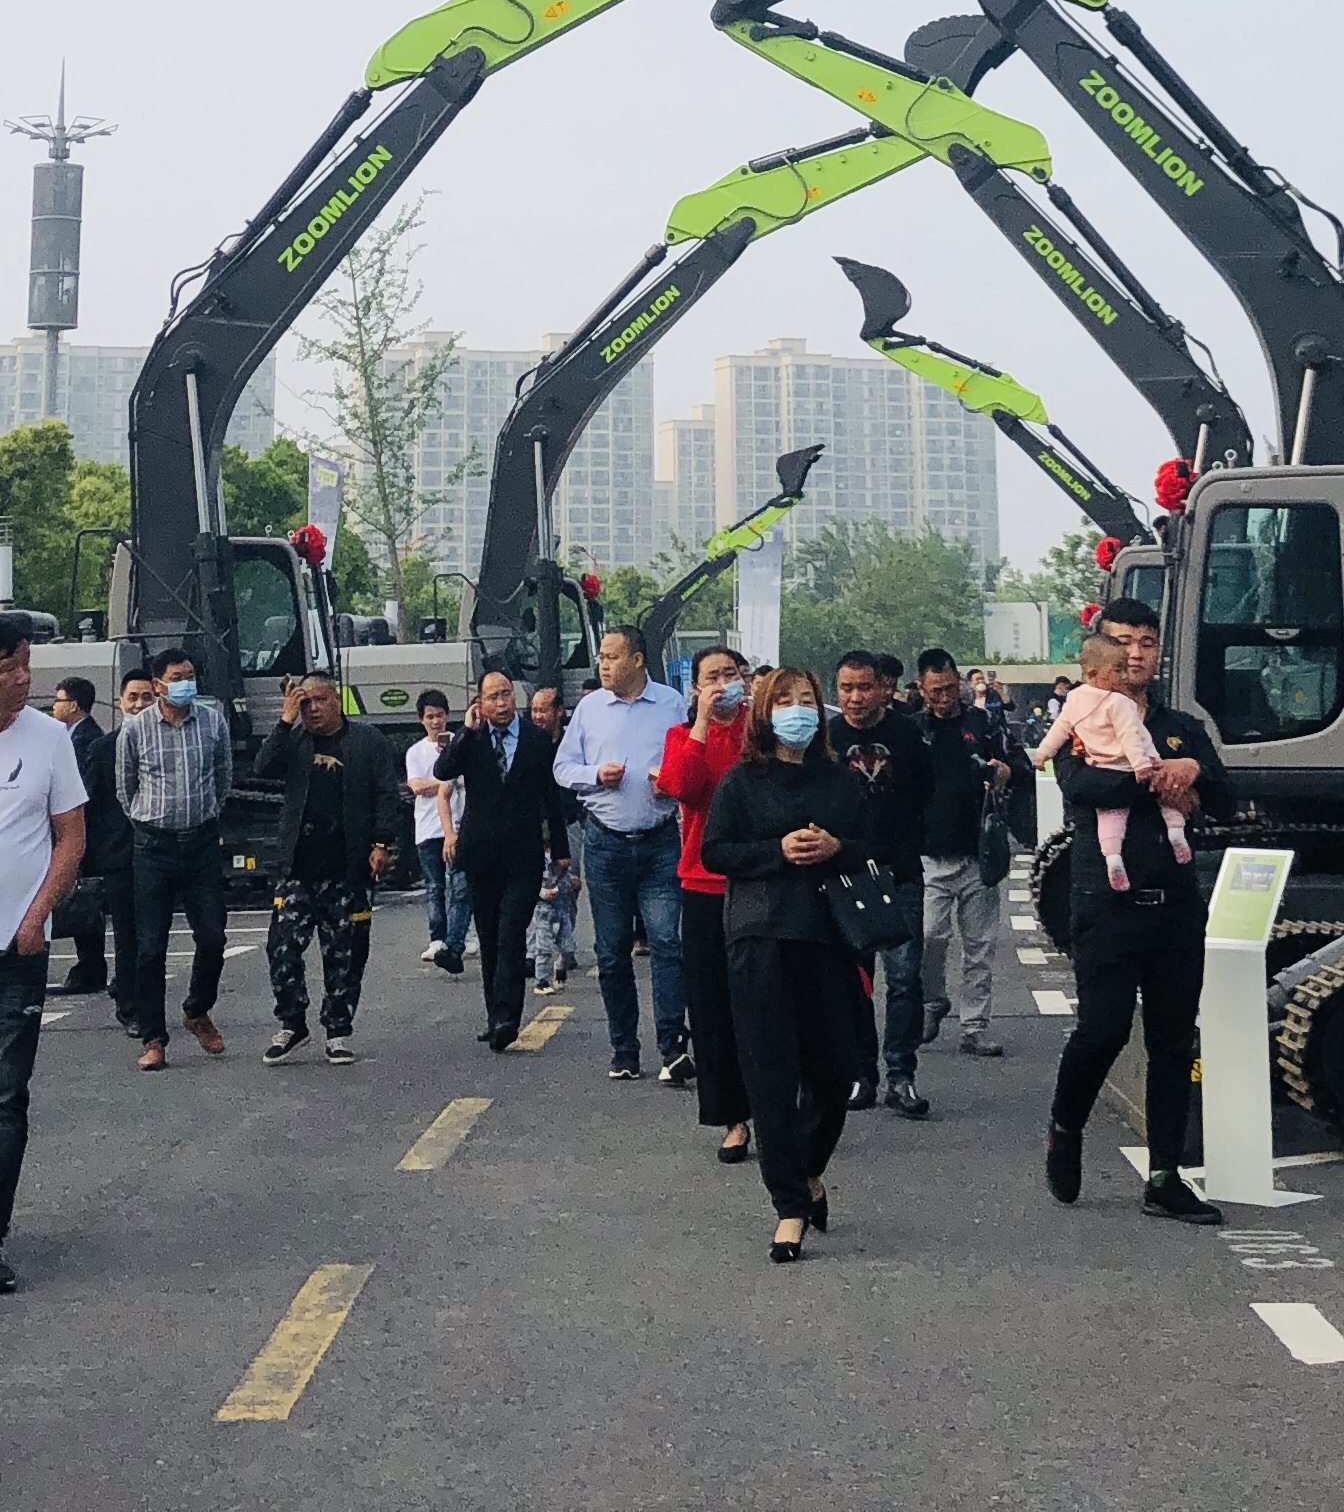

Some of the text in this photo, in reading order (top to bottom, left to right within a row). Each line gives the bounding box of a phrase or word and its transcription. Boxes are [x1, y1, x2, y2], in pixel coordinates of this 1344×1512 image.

[1078, 69, 1206, 197] ZOOMLION
[276, 144, 393, 273] ZOOMLION
[599, 284, 681, 364] ZOOMLION
[1022, 224, 1119, 325] ZOOMLION
[1037, 450, 1092, 501] ZOOMLION
